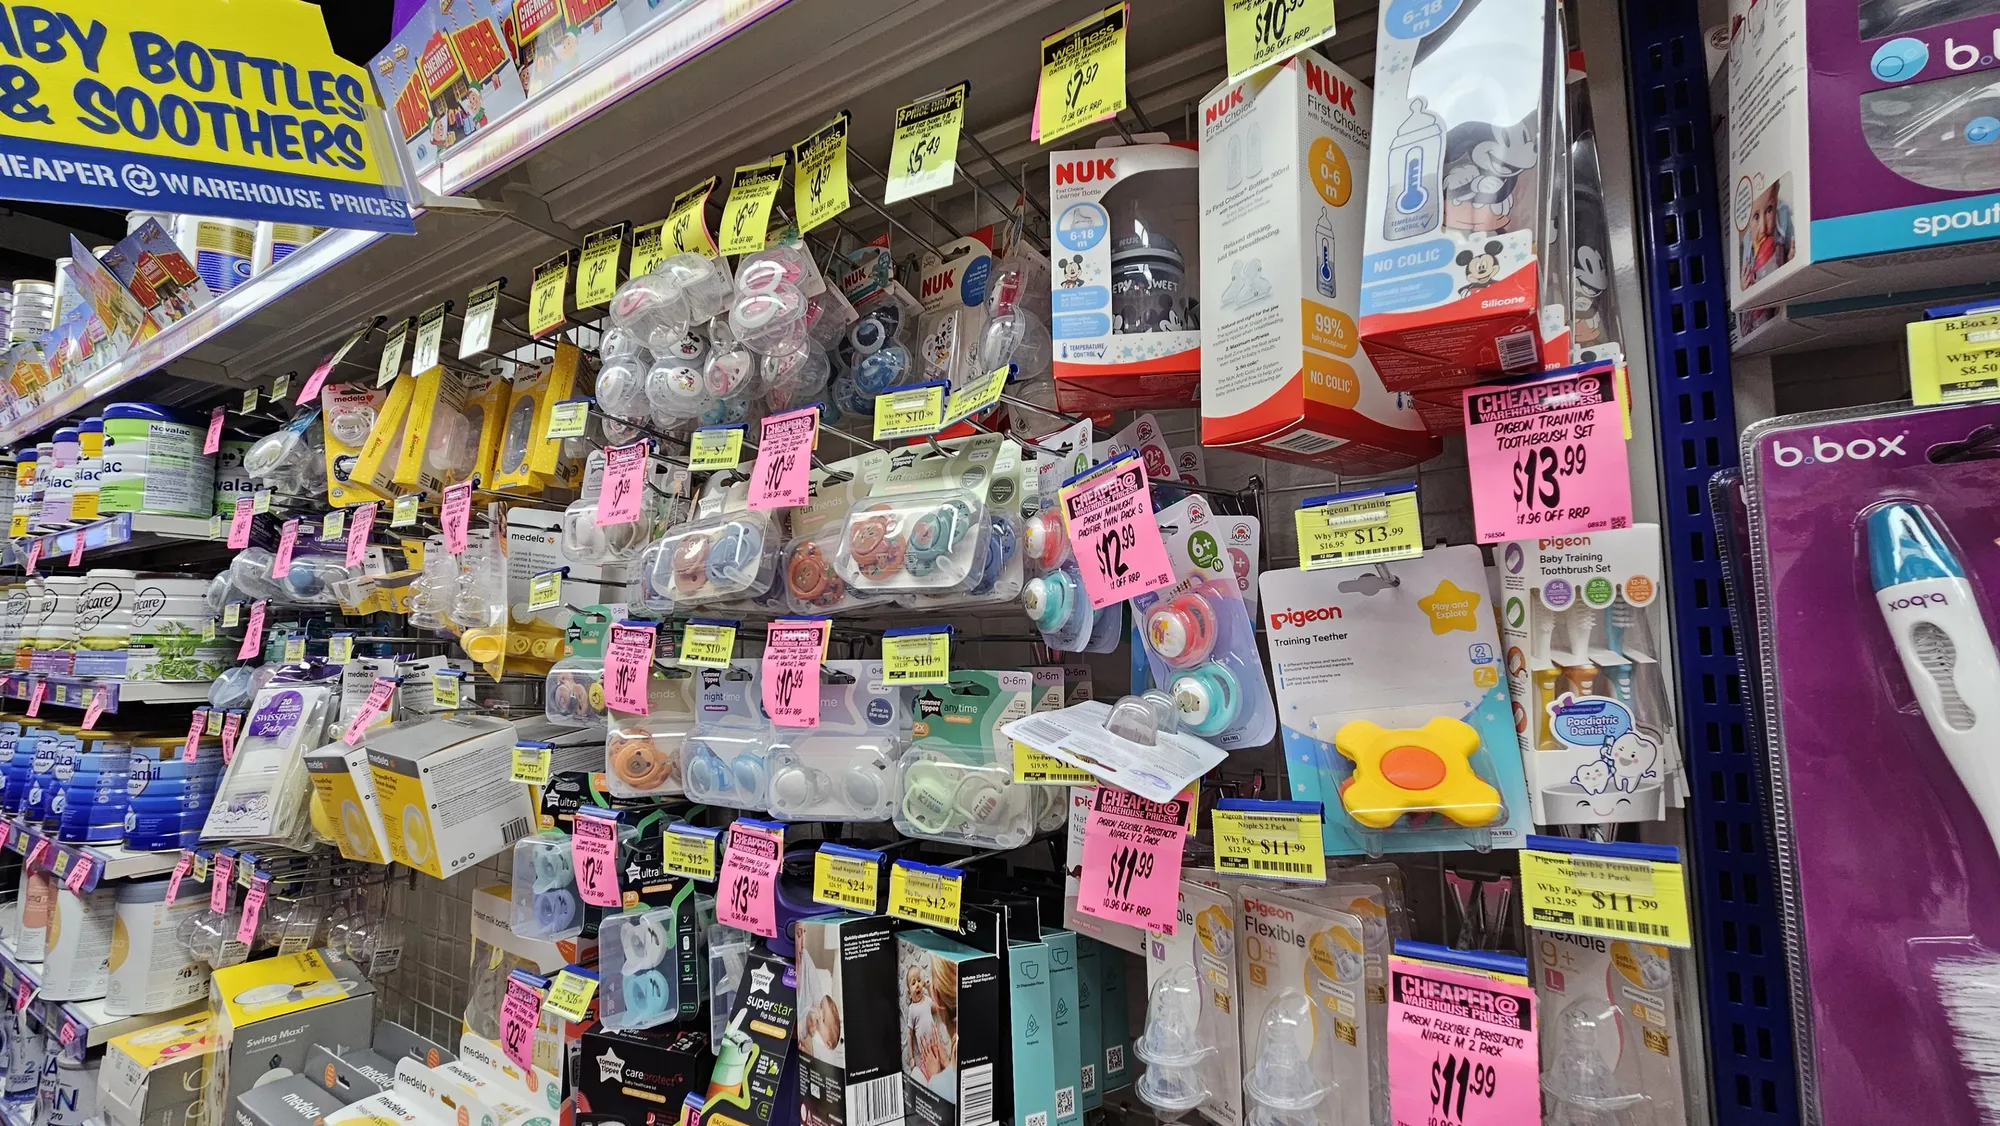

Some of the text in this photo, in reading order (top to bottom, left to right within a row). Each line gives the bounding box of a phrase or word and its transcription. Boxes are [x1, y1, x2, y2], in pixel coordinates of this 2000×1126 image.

[1402, 2, 1444, 25] 6-18
[1412, 19, 1430, 33] m
[1052, 24, 1114, 60] wellness
[452, 17, 508, 84] HERE!
[423, 44, 451, 77] CHEMIST
[130, 31, 365, 122] BOTTLES
[1066, 62, 1099, 113] $7.97
[1306, 59, 1356, 116] NUK
[1205, 85, 1244, 126] NUK
[1308, 94, 1330, 118] First
[0, 64, 367, 171] & SOOTHERS
[1206, 122, 1223, 137] First
[1056, 158, 1116, 185] NUK
[1321, 163, 1340, 186] 0-6
[1056, 189, 1101, 200] Learner Bottle
[1325, 184, 1337, 199] m
[330, 193, 407, 219] PRICES
[1391, 213, 1429, 227] TEMPERATURE
[1394, 223, 1419, 233] CONTROL
[1069, 230, 1094, 241] 6-18
[1373, 249, 1440, 273] NO COLIC
[844, 267, 866, 287] NUK
[921, 268, 956, 298] NUK
[1480, 295, 1525, 309] Silicone
[1315, 313, 1343, 339] 99%
[1945, 320, 1986, 331] B.Box
[1069, 343, 1104, 351] TEMPERATURE
[1947, 353, 1979, 363] Why
[1310, 369, 1324, 386] NO
[1961, 364, 1998, 375] $8.50
[334, 395, 366, 403] medela
[1479, 405, 1550, 423] WAREHOUSE
[150, 424, 190, 435] Novalac
[1494, 409, 1594, 437] PIGEON TRAINING
[1497, 424, 1595, 451] TOOTHBRUSH SET
[1772, 434, 1907, 468] b.box
[886, 469, 936, 482] funfriends
[1039, 462, 1056, 474] pigeon
[1513, 443, 1587, 512] $13.99
[1075, 484, 1138, 518] WAREHOUSE PRICES!!
[1320, 499, 1391, 516] Pigeon Training
[1083, 497, 1135, 527] PIGEON MINILIGHT
[1188, 509, 1206, 524] JAPAN
[1544, 509, 1564, 522] OFF
[1568, 506, 1590, 519] RRP
[1078, 503, 1144, 540] PACIFIER TWIN PACK S
[511, 532, 545, 543] medela
[1230, 532, 1251, 541] JAPAN
[1314, 530, 1349, 542] Why Pay
[1354, 526, 1404, 545] $13.99
[1539, 535, 1591, 551] pigeon
[1096, 523, 1136, 582] $12.99
[1191, 536, 1212, 556] 6+
[1319, 540, 1345, 550] $16.95
[1214, 560, 1224, 571] M
[1540, 553, 1603, 564] Baby Training
[1540, 564, 1611, 575] Toothbrush Set
[1431, 600, 1469, 612] Play and
[1436, 608, 1467, 619] Explore
[1271, 606, 1342, 630] pigeon
[1274, 631, 1348, 647] Training Teether
[1475, 645, 1485, 659] 2
[913, 654, 941, 667] $10.99
[347, 670, 370, 679] medela
[1003, 676, 1027, 686] 0-6m
[1036, 672, 1059, 680] 0-6m
[1065, 668, 1087, 678] 0-6m
[704, 692, 740, 702] nighttime
[255, 711, 299, 723] swisspers
[944, 703, 978, 715] anytime
[914, 723, 925, 732] 2x
[1567, 715, 1618, 726] Paediatric
[259, 722, 284, 736] Baby
[1571, 726, 1607, 736] Dentist
[1101, 804, 1178, 825] WAREHOUSE PRICES!!
[1097, 816, 1177, 840] PIGEON FLEXIBLE PERISTALTIC
[1109, 828, 1160, 846] NIPPLE Y 2 PACK
[1224, 835, 1255, 845] Why Pay
[1228, 845, 1251, 854] $12.95
[1260, 839, 1306, 856] $11.99
[1535, 855, 1564, 864] Pigeon
[1567, 858, 1605, 870] Flexible
[1107, 844, 1154, 901] $11.99
[1558, 867, 1588, 878] Nipple
[1607, 872, 1631, 883] Pack
[847, 879, 873, 893] $24.99
[1537, 882, 1583, 897] Why Pay
[1121, 901, 1134, 912] OFF
[1136, 905, 1151, 917] RRP
[1544, 896, 1577, 907] $12.95
[1591, 890, 1658, 913] $11.99
[1244, 899, 1294, 922] pigeon
[1245, 916, 1306, 948] Flexible
[1154, 944, 1162, 957] Y
[1253, 967, 1263, 982] S
[1551, 971, 1560, 987] L
[747, 995, 793, 1018] superstar
[1403, 993, 1520, 1029] WAREHOUSE PRICES!!
[768, 1013, 776, 1022] top
[777, 1016, 790, 1026] straw
[1402, 1011, 1524, 1049] PIGEON FLEXIBLE PERISTALTIC
[1421, 1028, 1504, 1058] NIPPLE M 2 PACK
[462, 1045, 490, 1065] medela
[398, 1072, 428, 1093] medela
[625, 1068, 676, 1087] careprotect
[1431, 1051, 1496, 1123] $11.99
[281, 1092, 322, 1120] medela
[376, 1095, 408, 1118] medela
